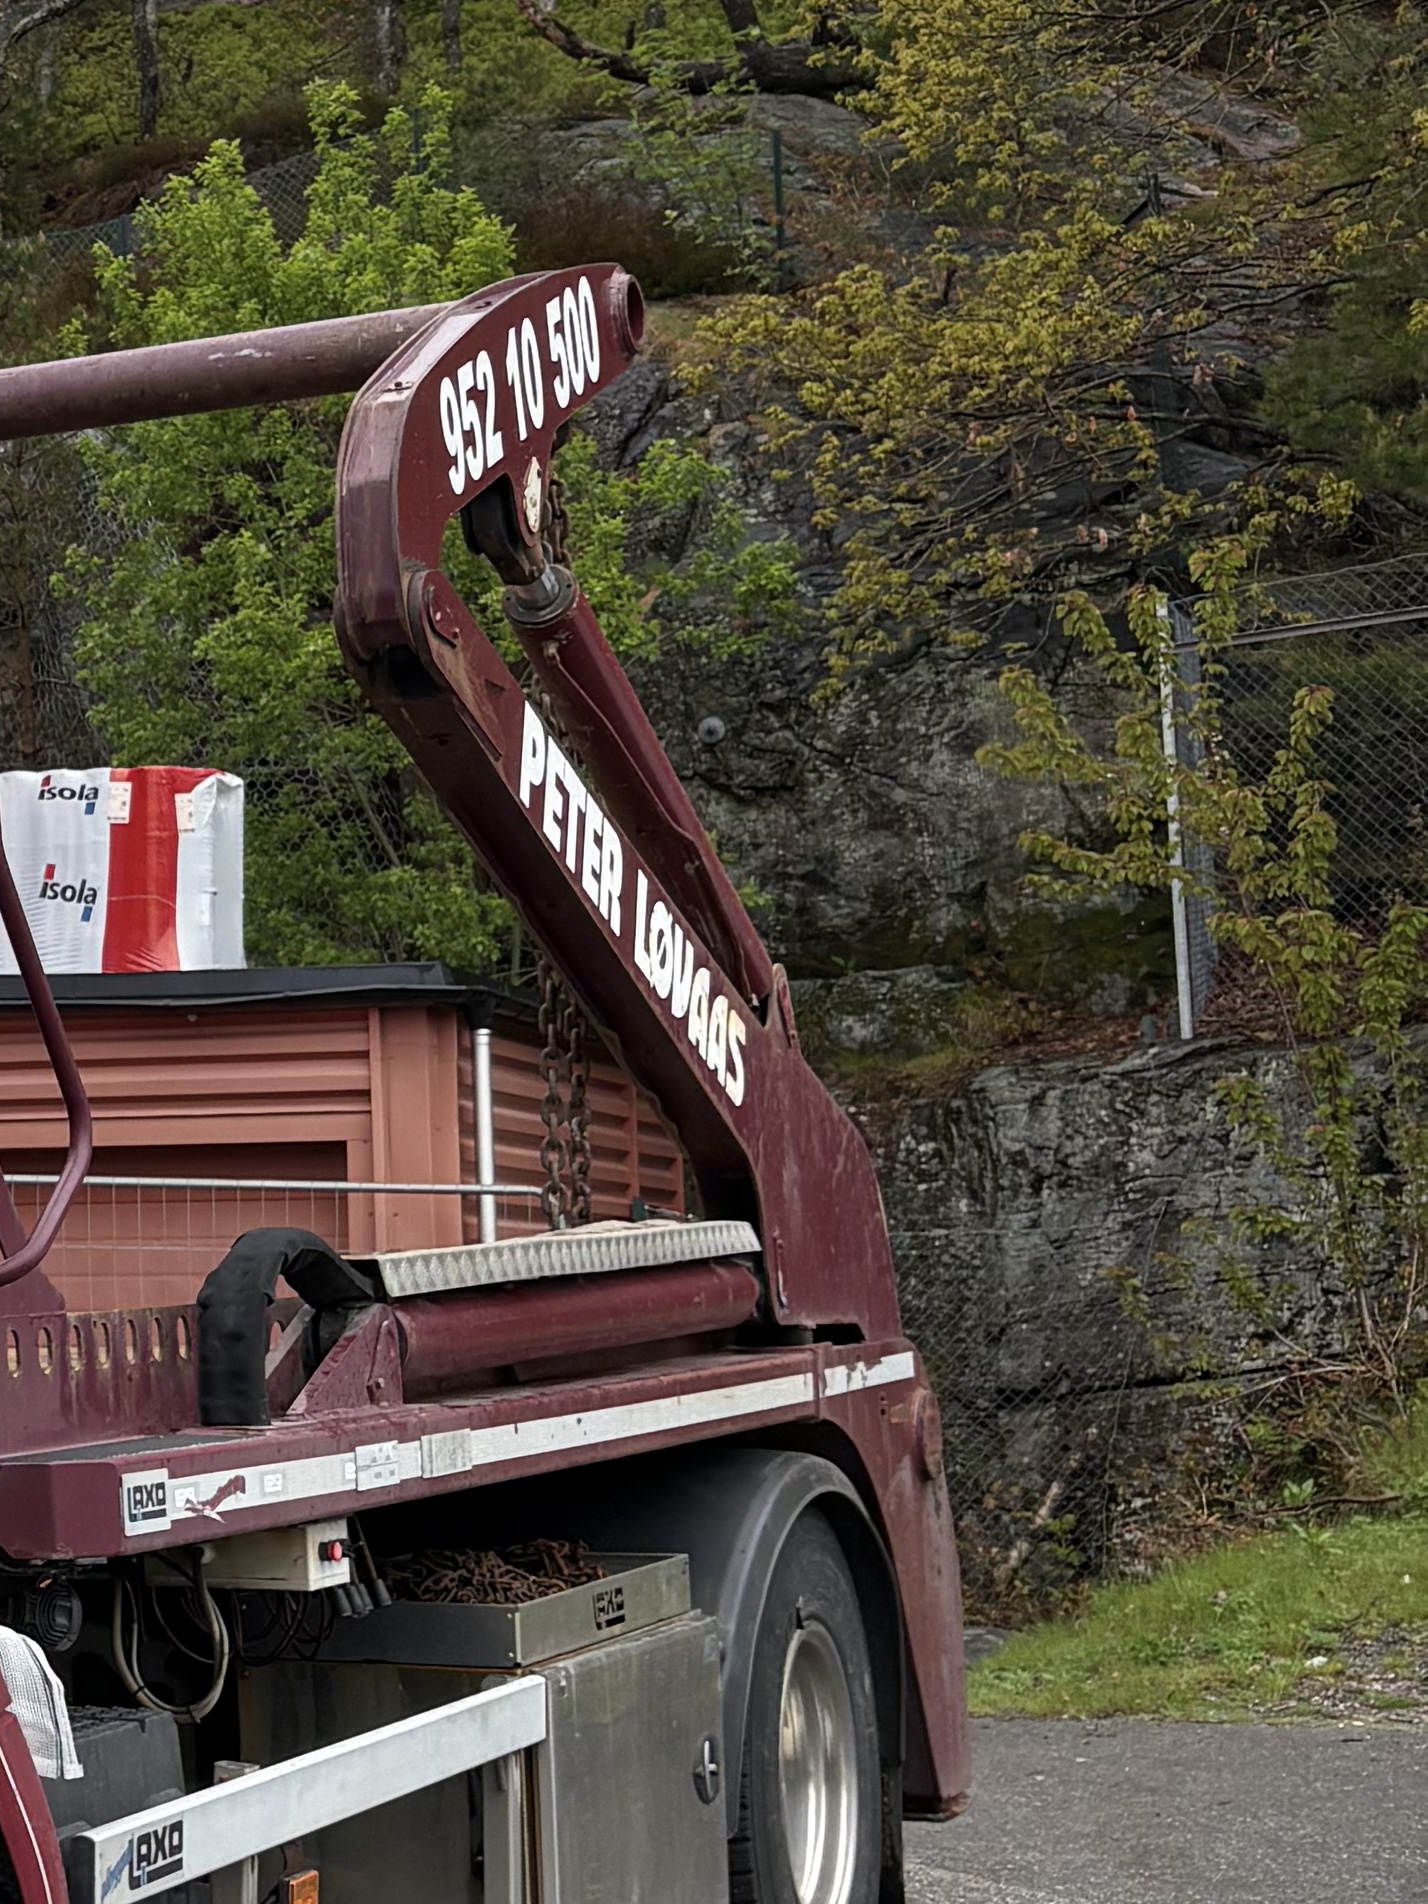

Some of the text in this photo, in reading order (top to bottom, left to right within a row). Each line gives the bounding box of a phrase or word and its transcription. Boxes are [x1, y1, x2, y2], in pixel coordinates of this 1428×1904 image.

[438, 275, 602, 496] 952 10 500
[38, 775, 99, 802] isola
[39, 864, 98, 906] isola
[519, 700, 746, 1107] PETER LØVAAS
